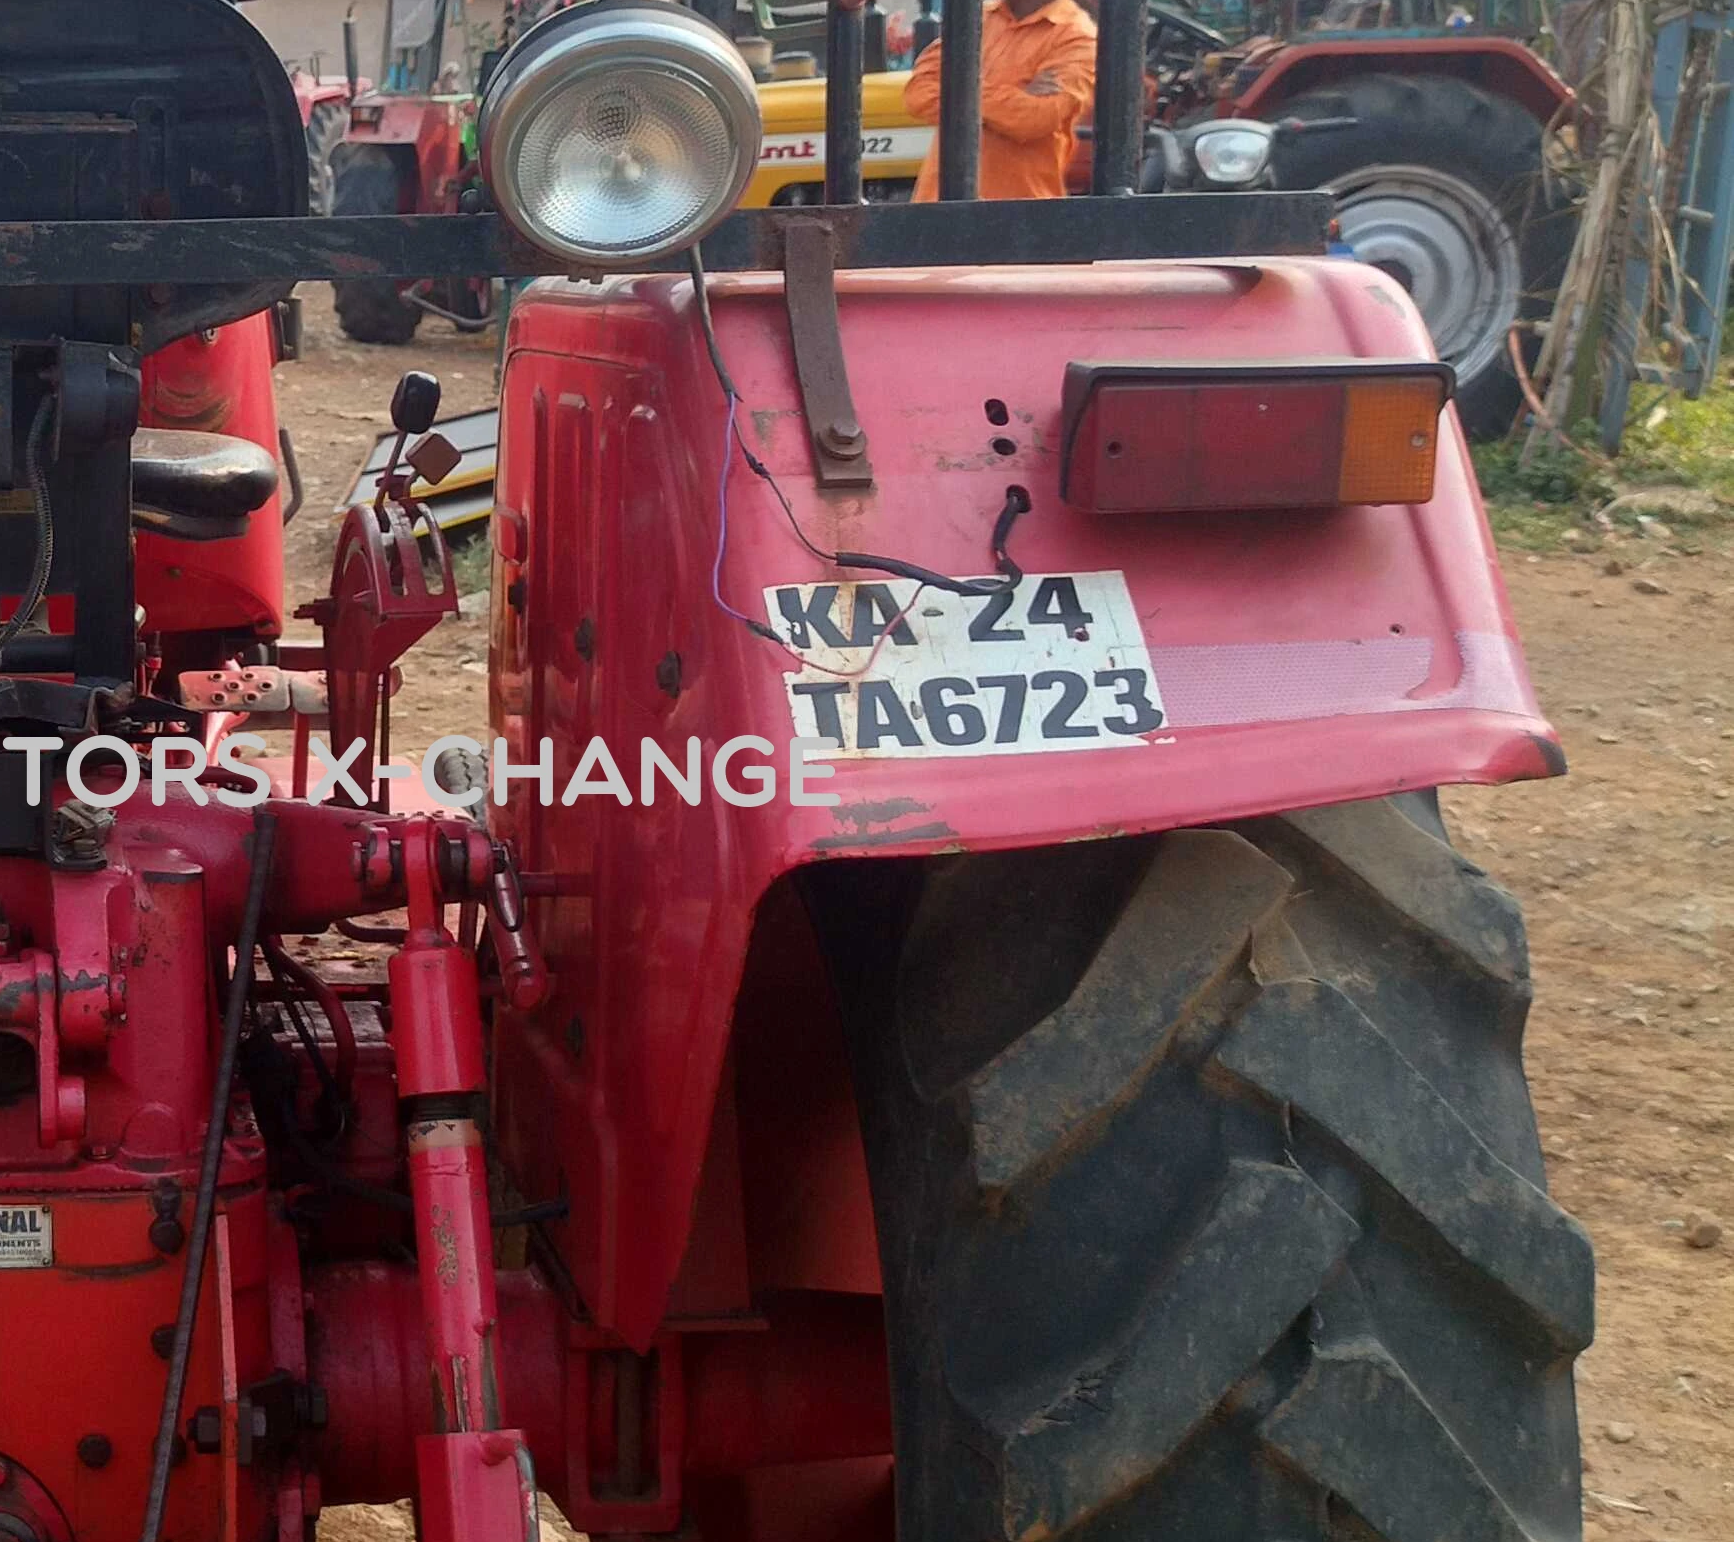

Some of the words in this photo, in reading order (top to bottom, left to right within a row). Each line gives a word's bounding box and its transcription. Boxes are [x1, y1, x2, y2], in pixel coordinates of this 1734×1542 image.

[757, 139, 817, 160] mt
[775, 583, 919, 649] KA
[958, 576, 1095, 643] 24
[792, 668, 1164, 749] TA6723
